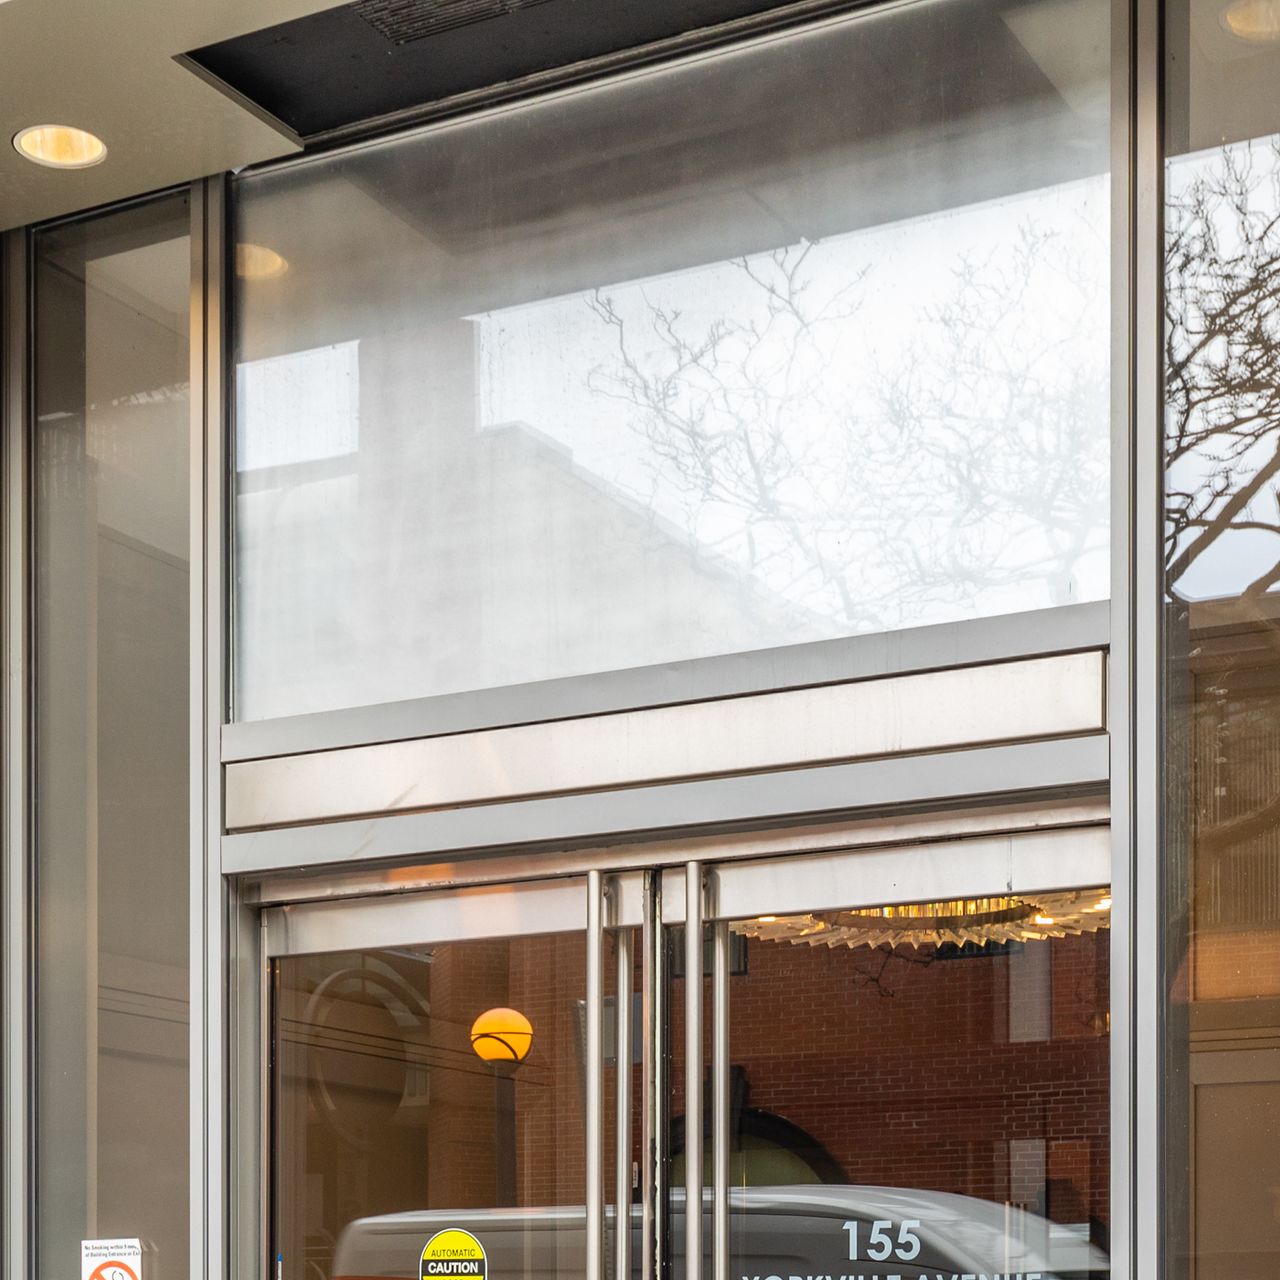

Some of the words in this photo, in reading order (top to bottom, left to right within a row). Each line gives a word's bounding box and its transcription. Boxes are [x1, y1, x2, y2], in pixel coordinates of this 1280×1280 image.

[842, 1220, 920, 1261] 155
[431, 1249, 476, 1258] AUTOMATIC
[428, 1262, 479, 1274] CAUTION
